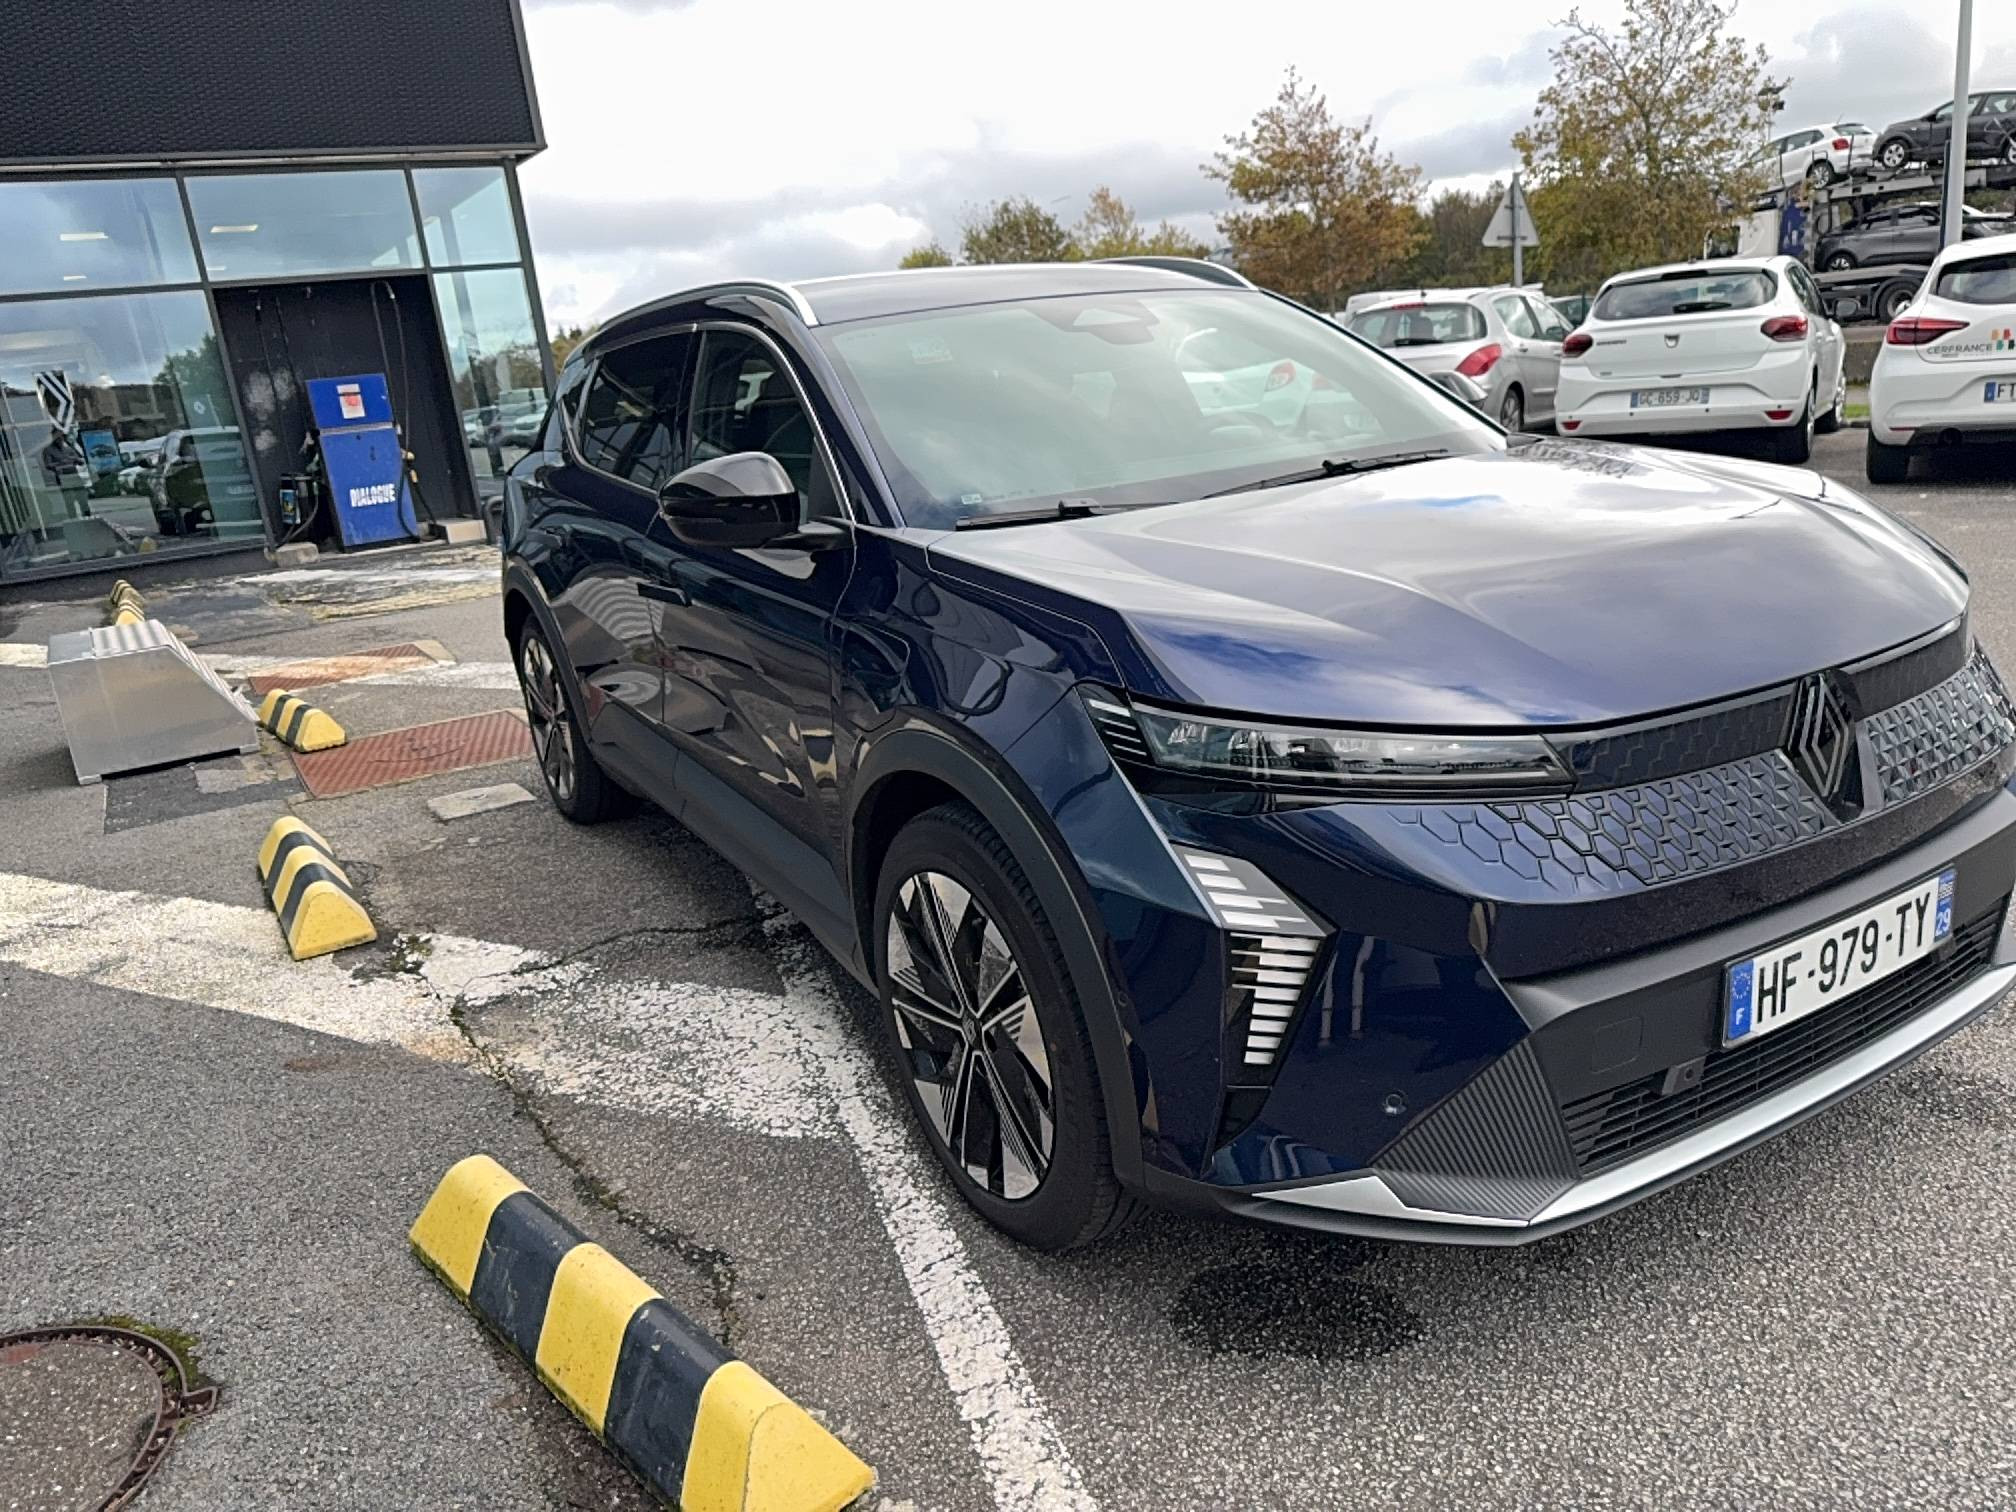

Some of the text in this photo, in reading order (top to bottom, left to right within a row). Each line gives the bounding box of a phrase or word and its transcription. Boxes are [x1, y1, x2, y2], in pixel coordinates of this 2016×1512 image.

[1926, 343, 1993, 355] CERFRANCE
[350, 483, 396, 508] DIALOGUE
[1935, 908, 1952, 937] 29
[1735, 891, 1931, 1026] F HF-979-TY
